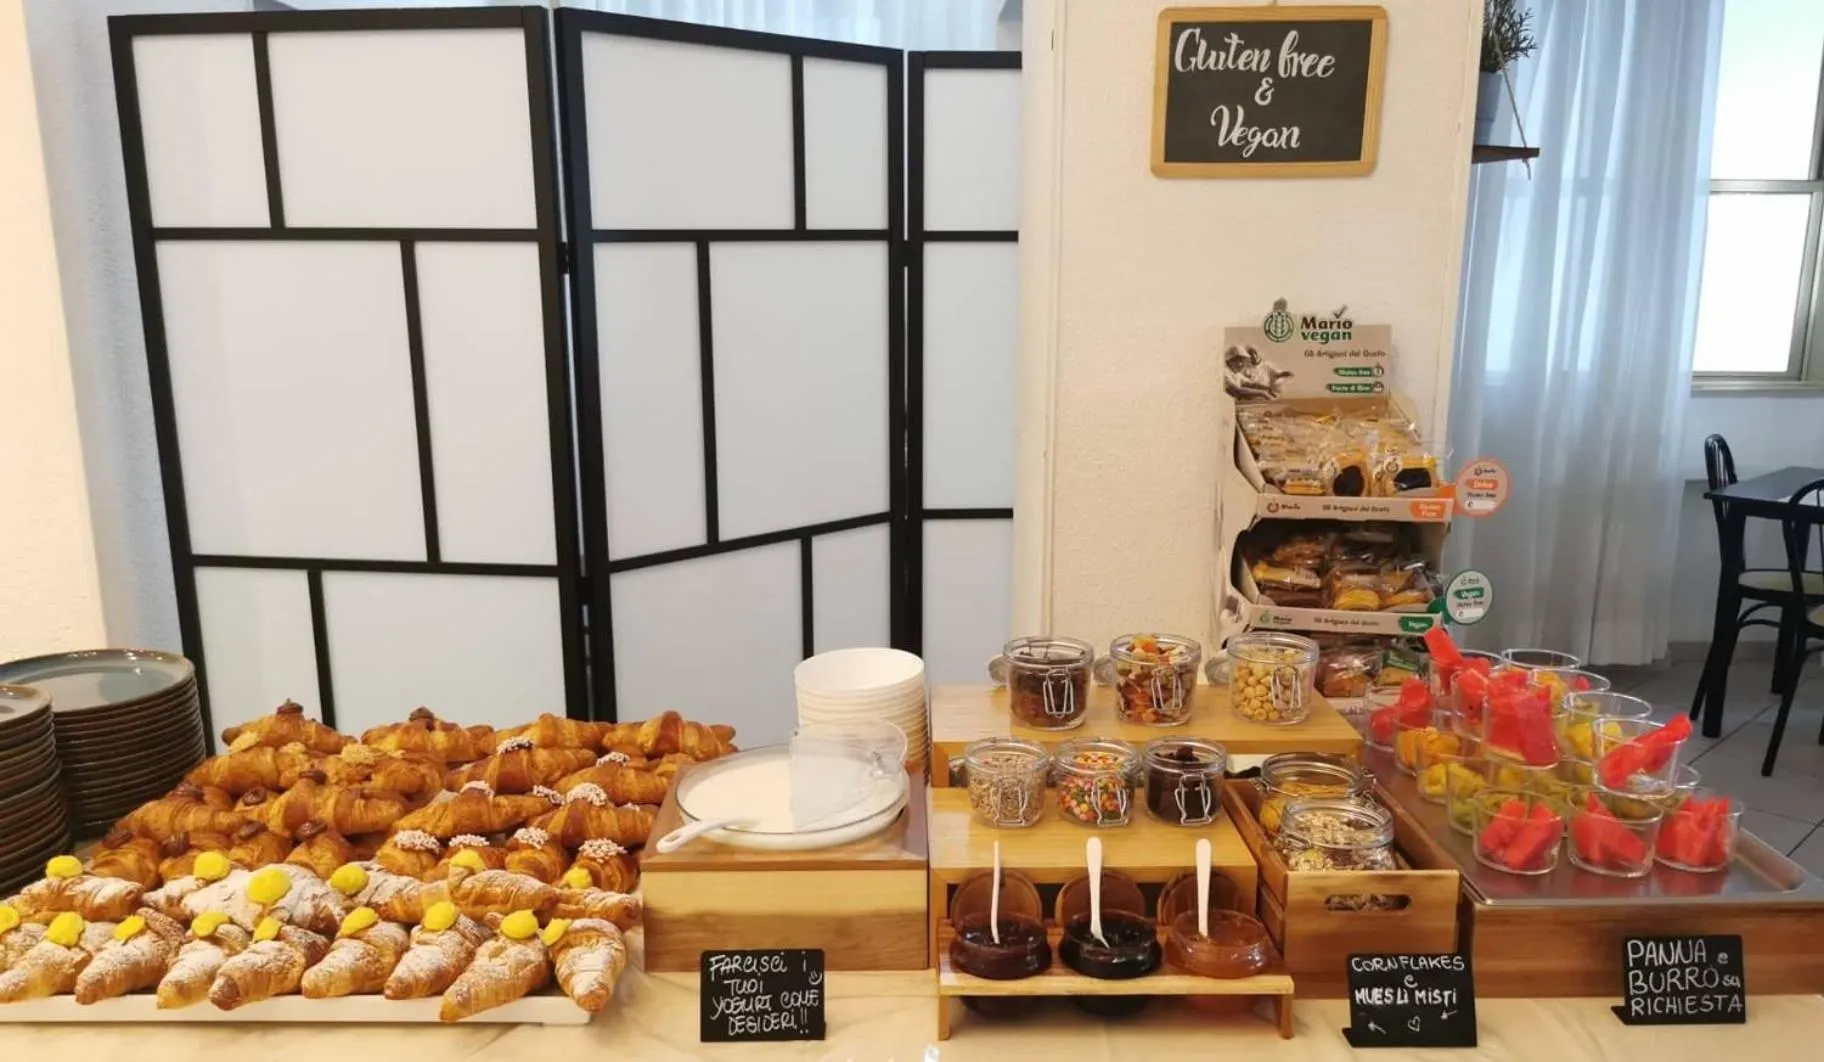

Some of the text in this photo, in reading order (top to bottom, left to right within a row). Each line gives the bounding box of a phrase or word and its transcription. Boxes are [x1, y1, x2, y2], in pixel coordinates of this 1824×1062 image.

[1174, 28, 1336, 79] Gluten free
[1254, 77, 1275, 106] &
[1210, 104, 1301, 158] Vegan
[1300, 316, 1353, 330] Mario
[1300, 330, 1353, 345] vegan
[1627, 939, 1729, 968] PANNA e
[1403, 974, 1418, 988] e
[1628, 966, 1719, 996] BURRO
[710, 994, 773, 1020] YOGURT
[1631, 994, 1743, 1017] RICHIESTA
